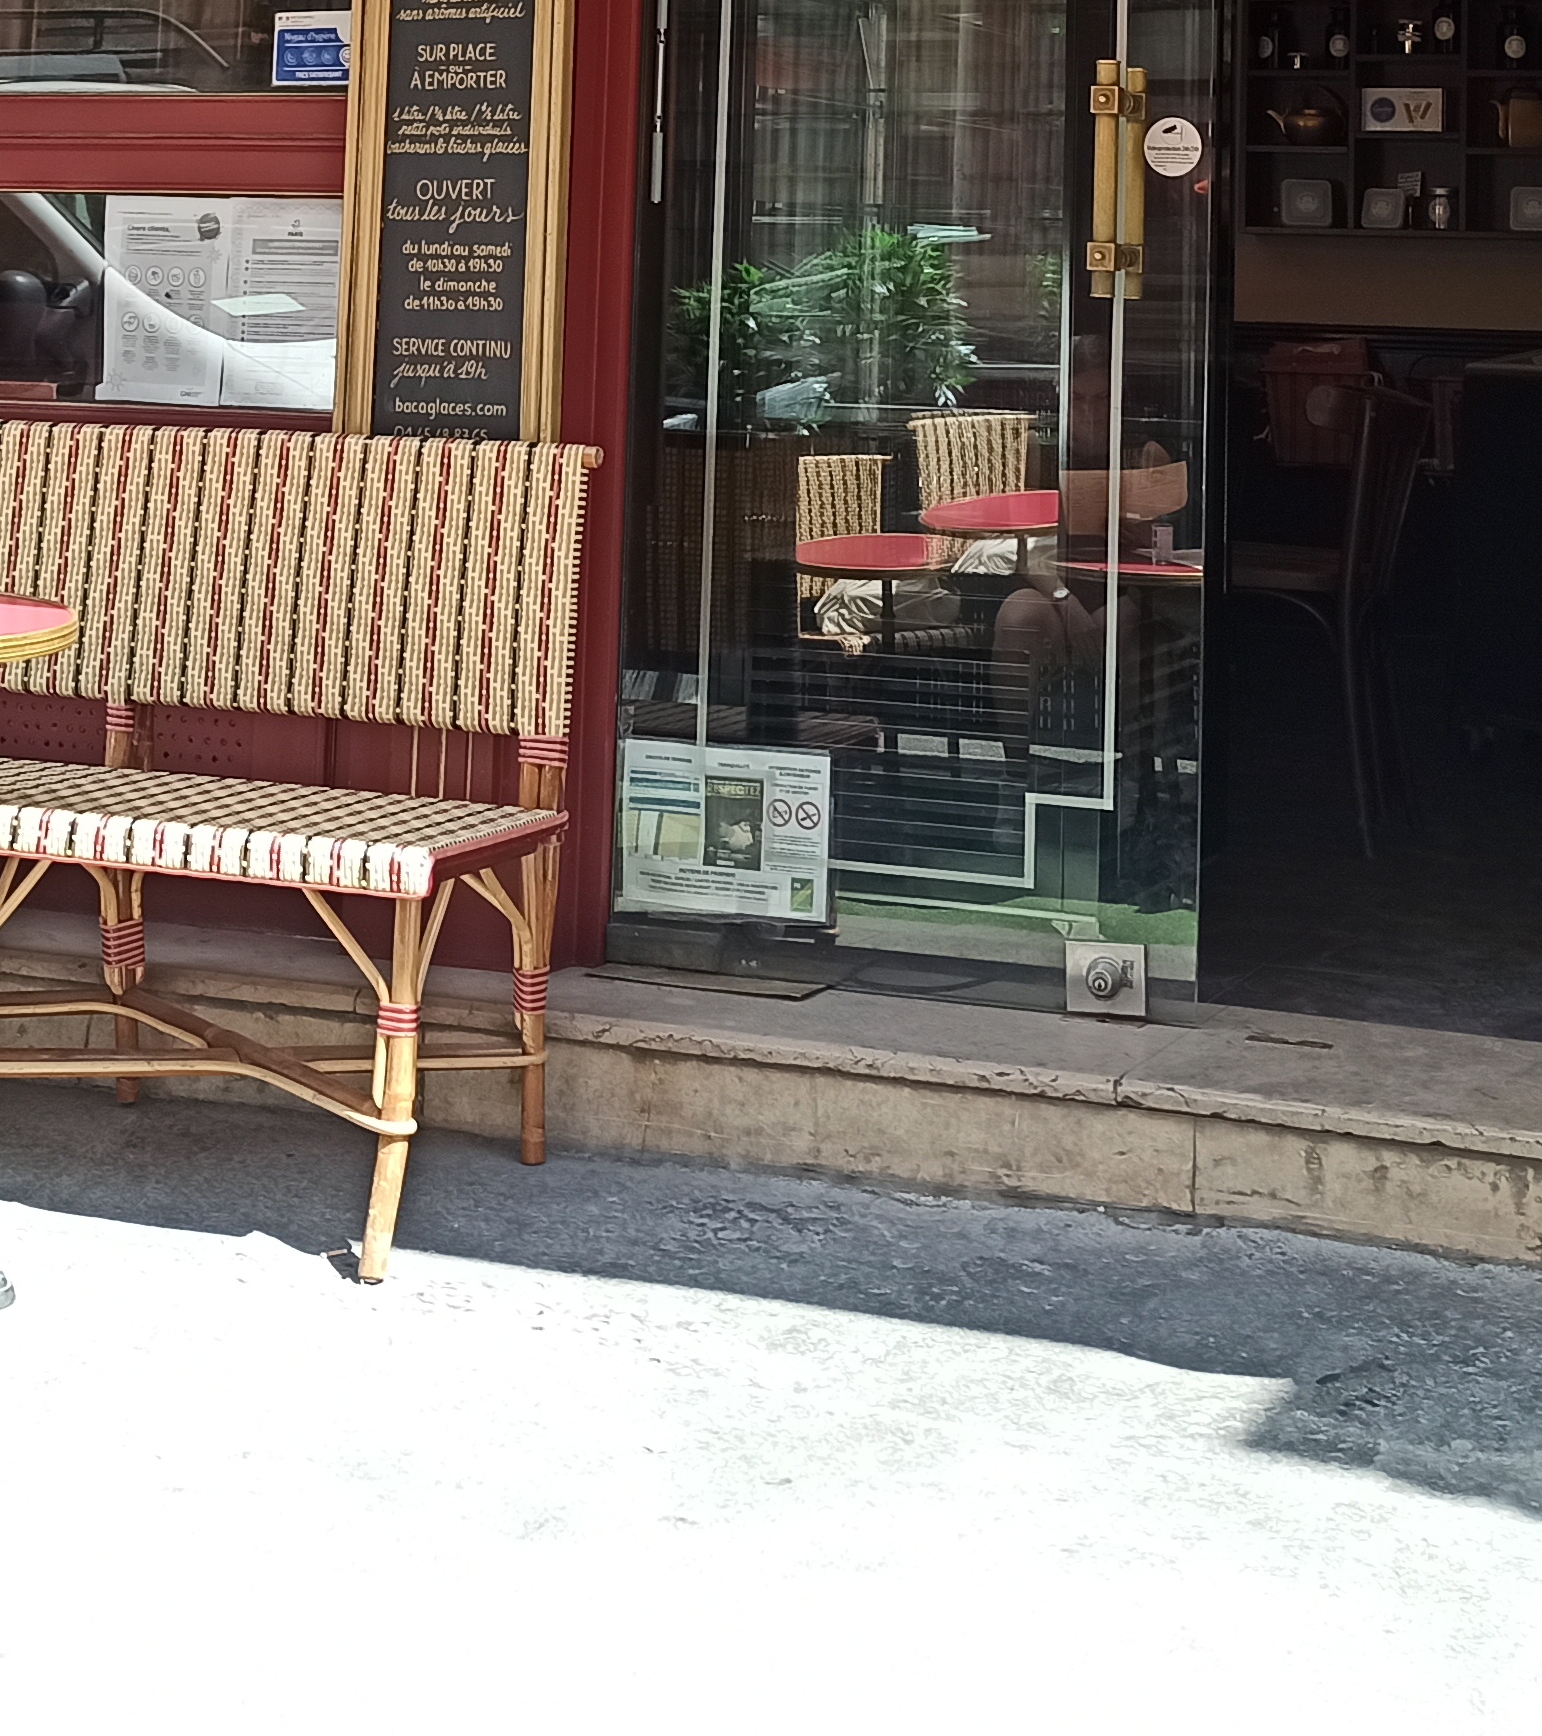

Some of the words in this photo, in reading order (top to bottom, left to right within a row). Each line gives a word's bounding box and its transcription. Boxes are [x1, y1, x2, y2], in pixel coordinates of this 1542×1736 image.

[396, 8, 423, 20] sans
[468, 1, 526, 24] artificiel
[417, 44, 446, 61] SUR
[449, 43, 497, 61] PLACE
[410, 66, 422, 89] À
[425, 70, 507, 89] EMPORTER
[416, 178, 496, 200] OUVERT
[386, 198, 420, 220] tous
[421, 199, 446, 220] les
[448, 201, 524, 233] jours
[402, 240, 418, 253] du
[422, 239, 452, 255] lundi
[453, 245, 469, 255] au
[473, 241, 513, 256] samedi
[409, 258, 424, 272] de
[425, 259, 456, 272] 10h30
[458, 260, 466, 272] à
[468, 259, 503, 272] 19h30
[420, 275, 431, 291] le
[434, 277, 496, 292] dimanche
[404, 295, 420, 309] de
[457, 297, 465, 310] à
[466, 296, 503, 310] 19h30
[392, 338, 446, 356] SERVICE
[450, 339, 511, 359] CONTINU
[390, 361, 456, 388] jusqu'à
[457, 363, 489, 380] 19h
[395, 397, 507, 420] bacaglaces.com
[708, 781, 761, 796] RESPECTEZ
